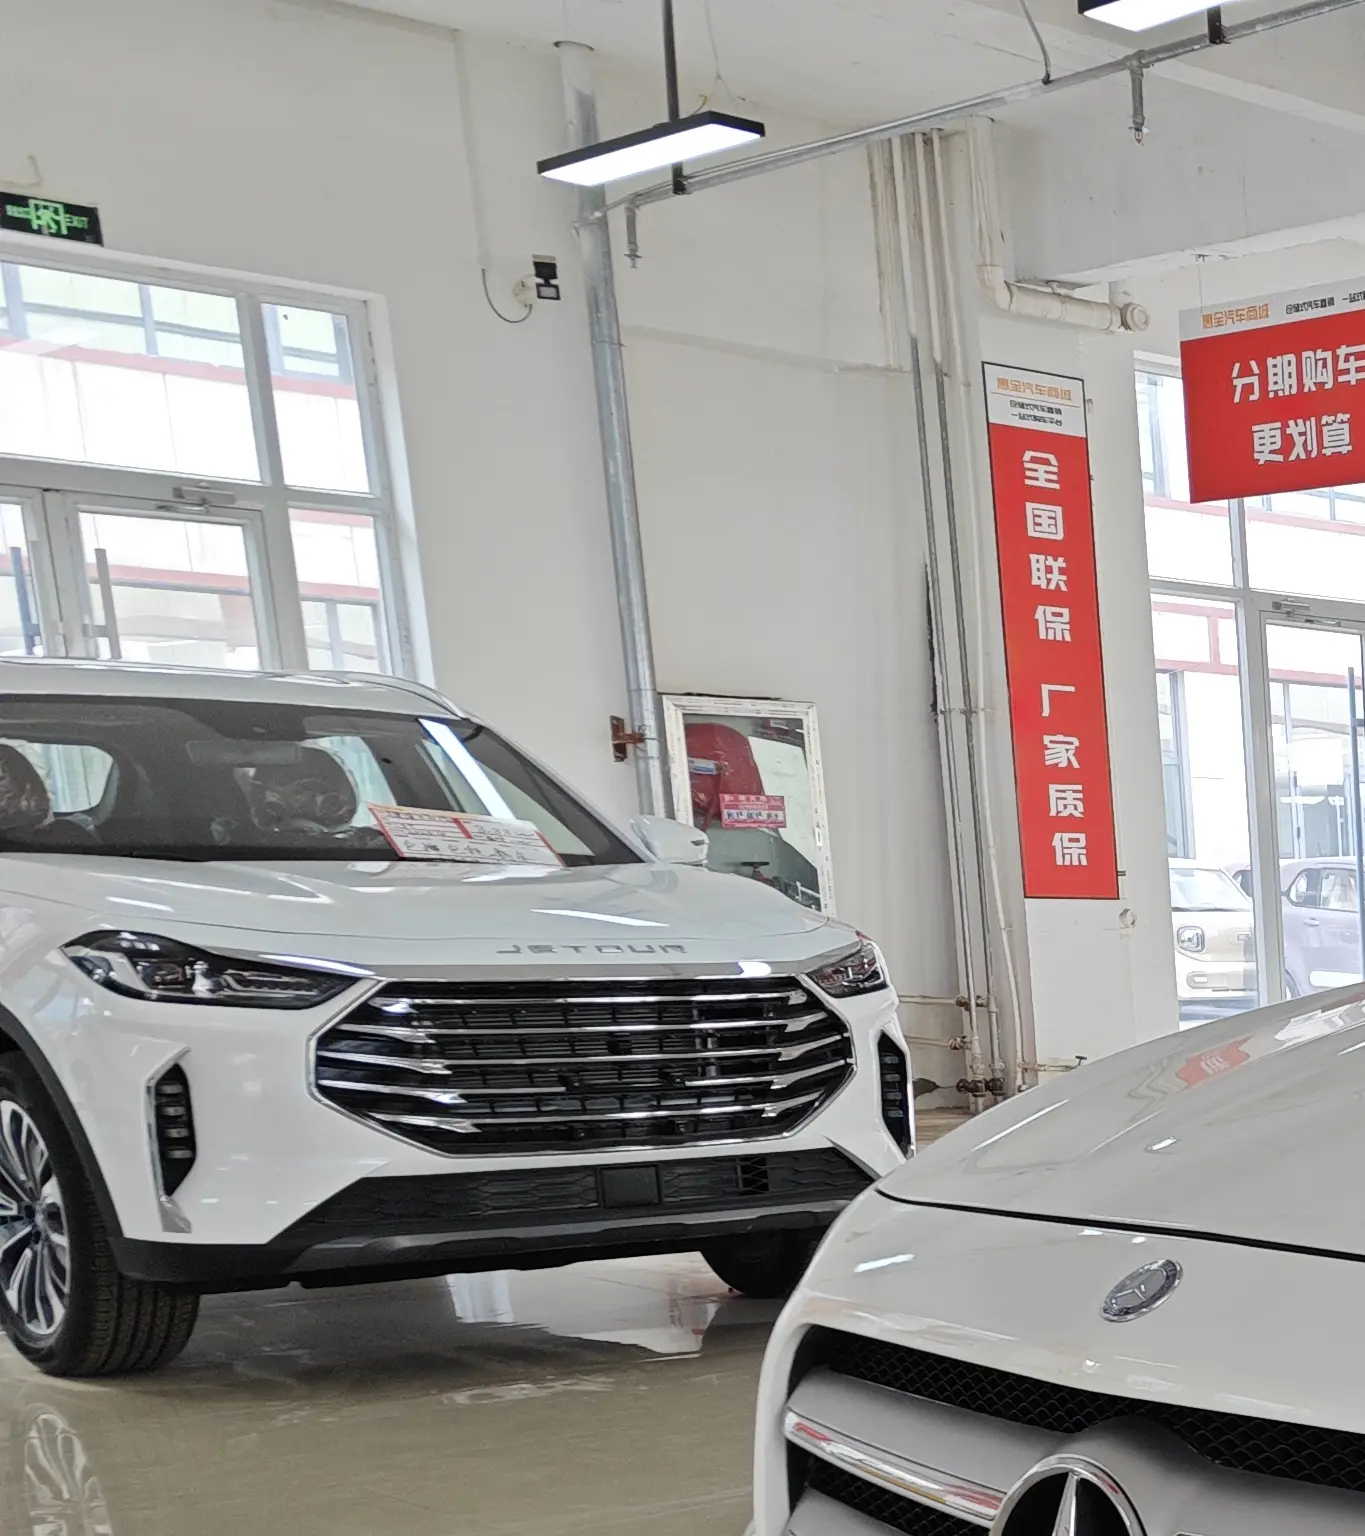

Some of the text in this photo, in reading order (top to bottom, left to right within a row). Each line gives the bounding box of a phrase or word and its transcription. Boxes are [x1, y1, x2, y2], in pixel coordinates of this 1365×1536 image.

[1203, 303, 1270, 330] 惠全汽车商城
[1252, 413, 1353, 465] 更划算
[1022, 450, 1088, 866] 全国联保 厂家质保
[496, 944, 688, 954] JETOUR
